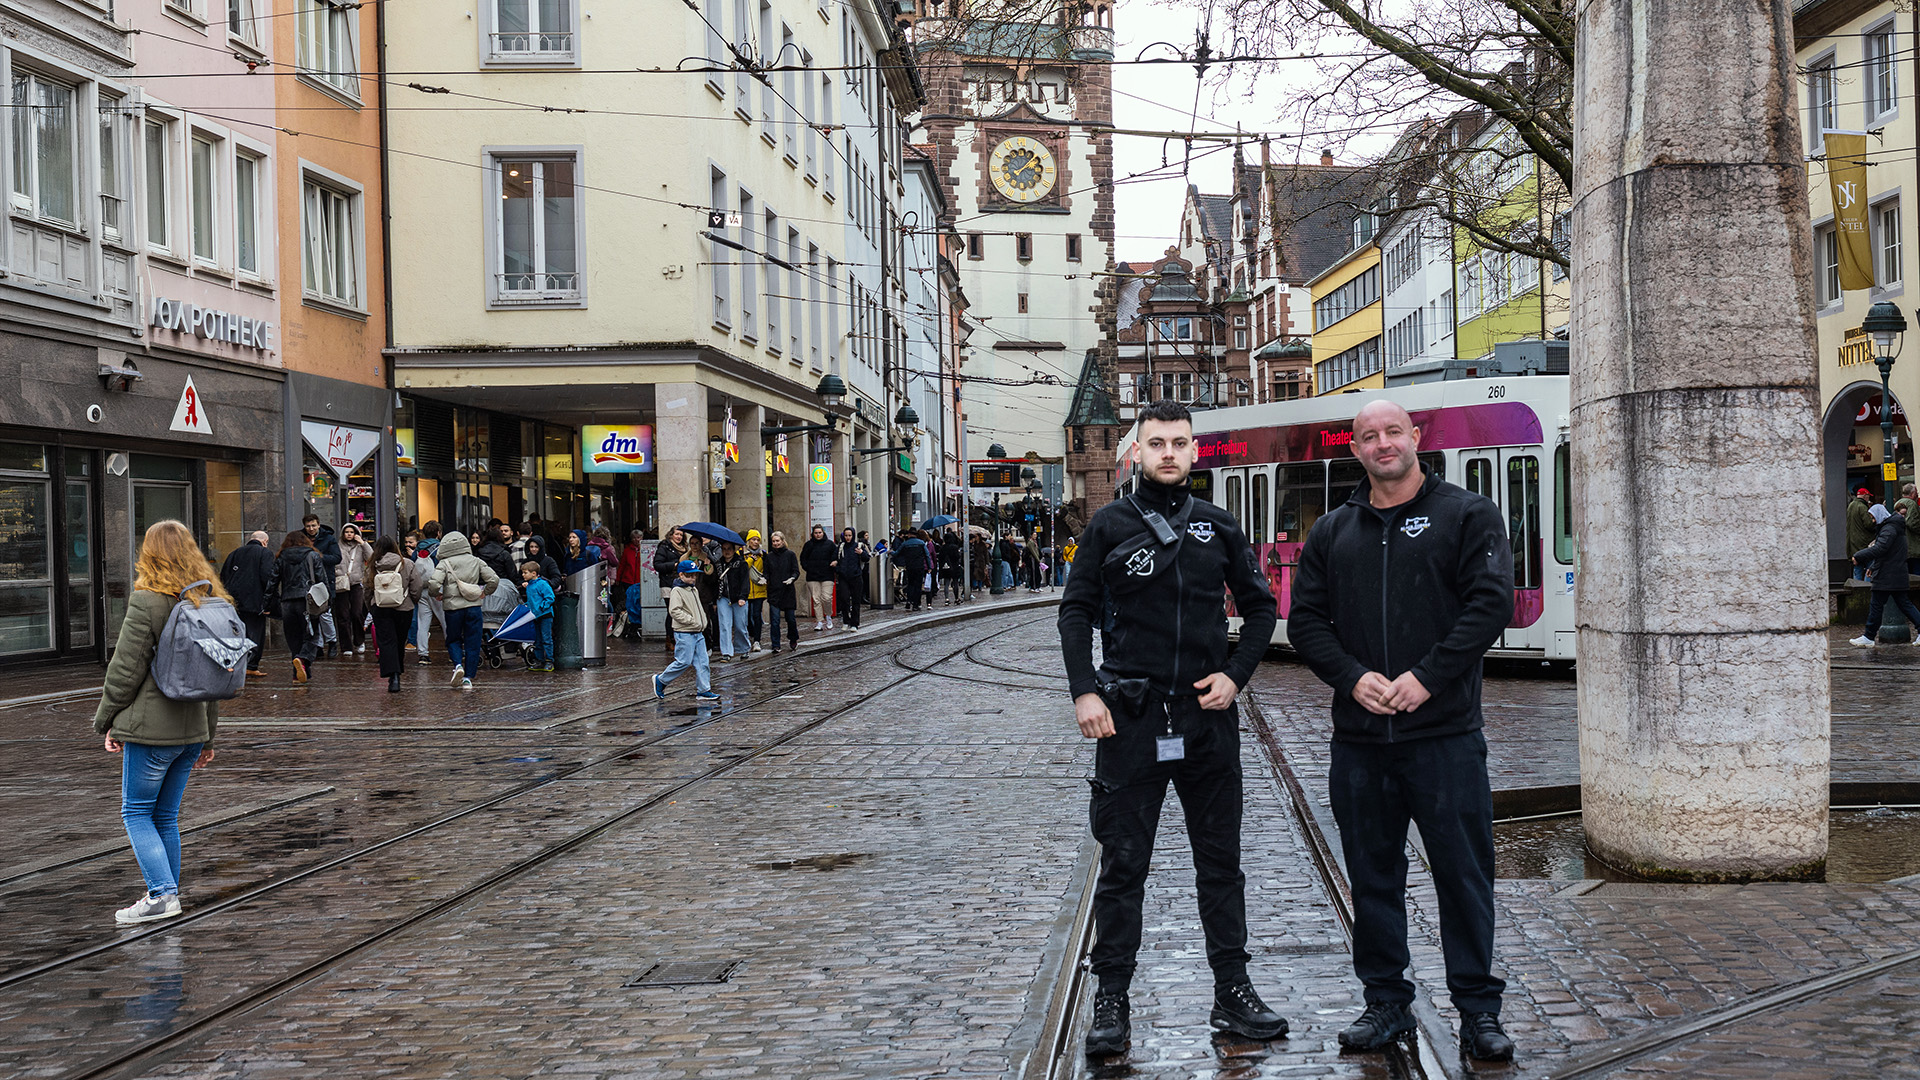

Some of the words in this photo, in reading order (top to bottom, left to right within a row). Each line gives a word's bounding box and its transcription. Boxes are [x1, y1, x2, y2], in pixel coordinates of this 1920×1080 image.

[729, 216, 739, 224] VA
[1838, 339, 1876, 368] NITTEL
[1488, 385, 1506, 399] 260
[602, 433, 637, 453] dm
[1320, 430, 1353, 446] Theater
[1198, 442, 1215, 457] eater
[1216, 440, 1248, 457] Freiburg
[331, 458, 352, 467] BACKSHOP
